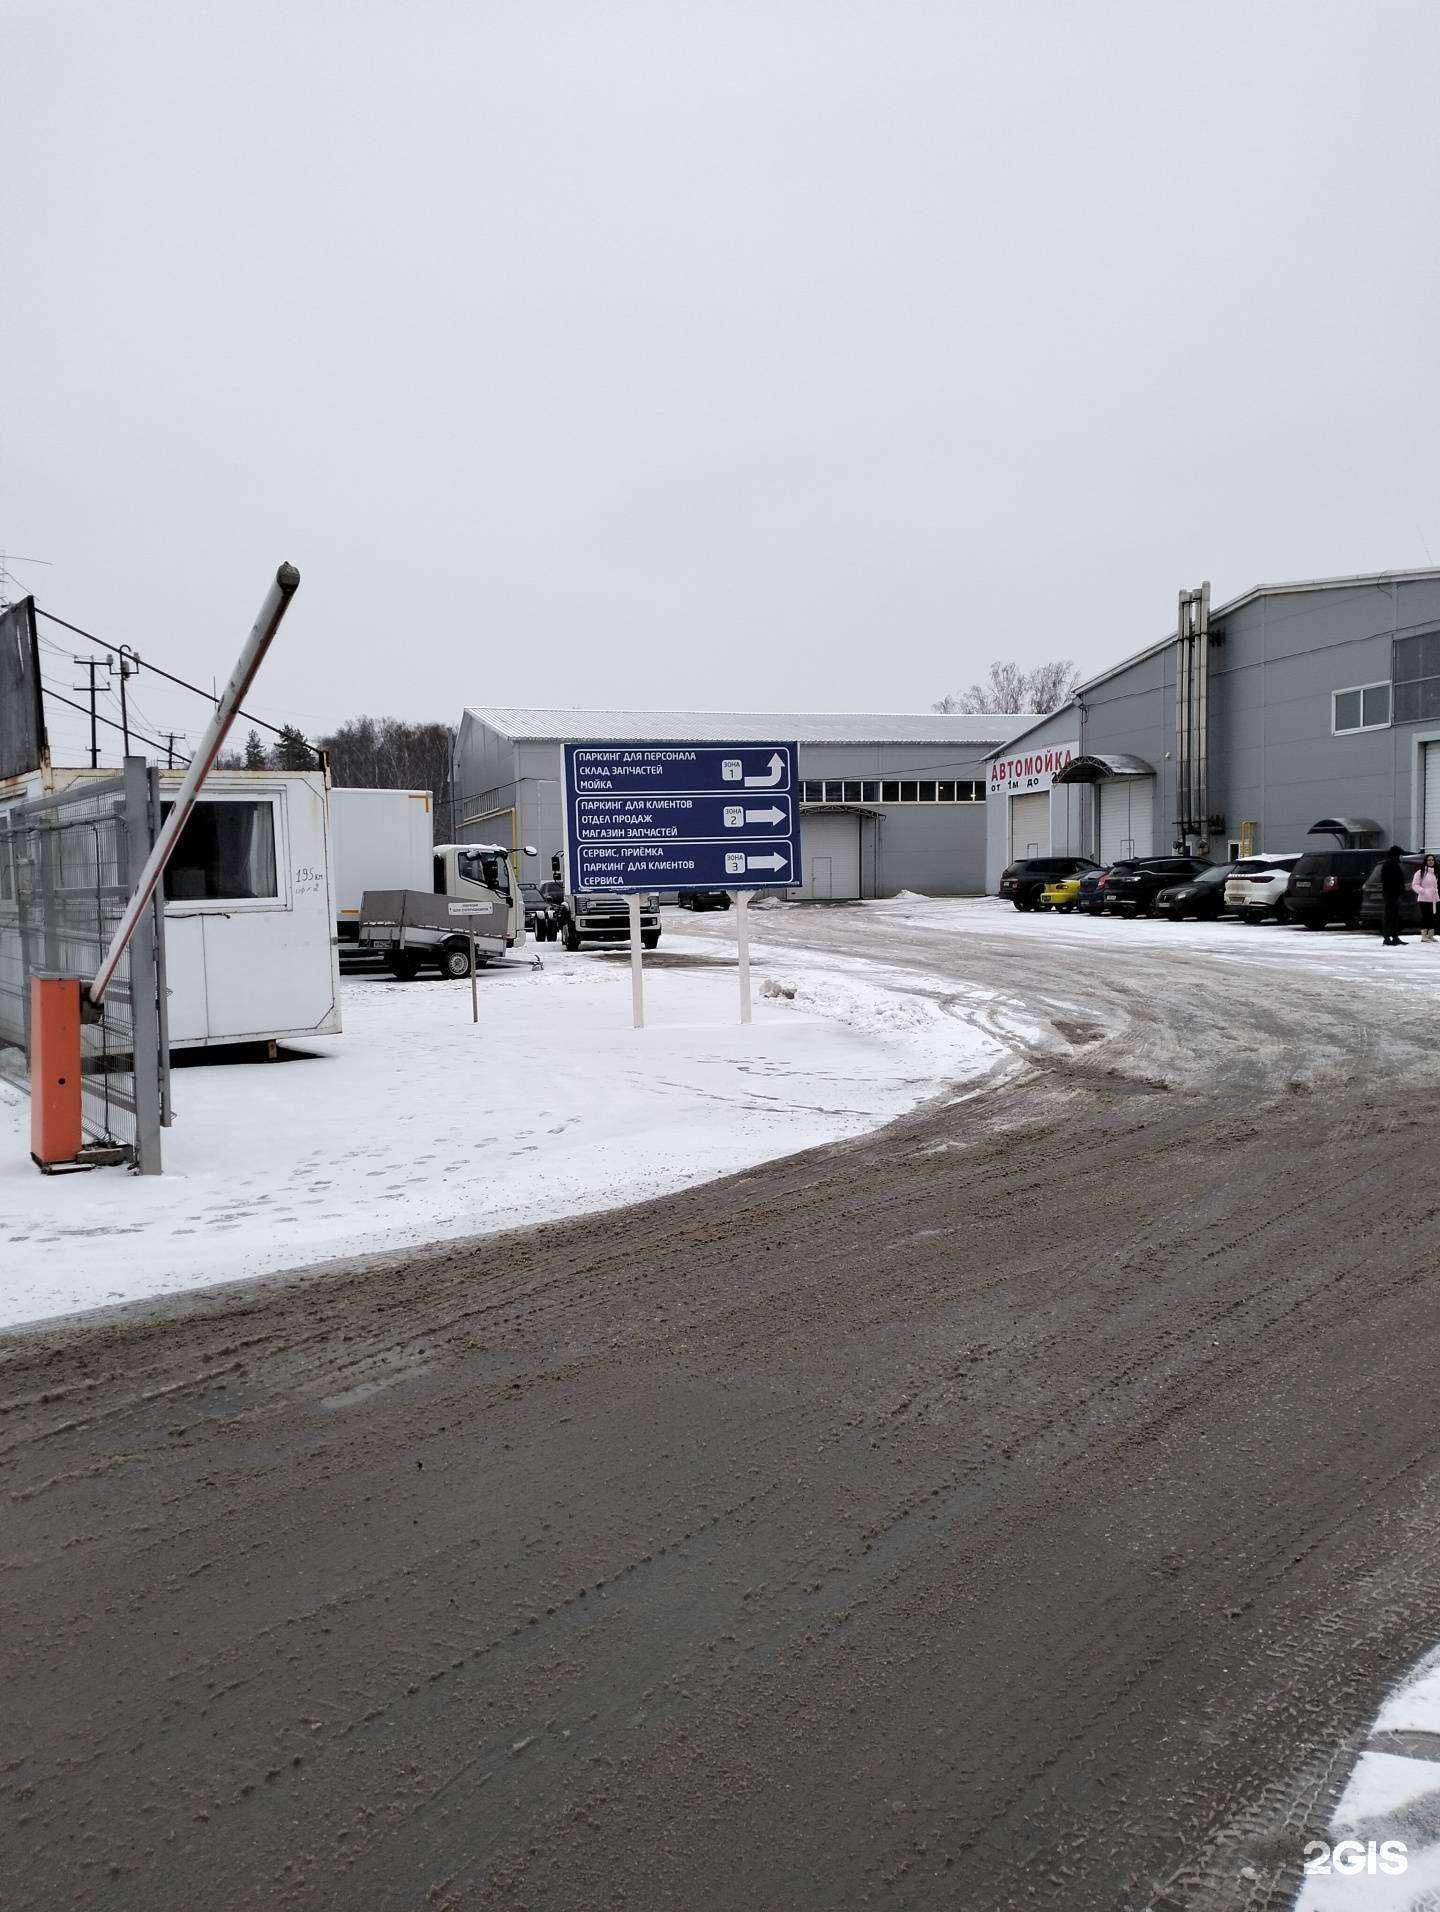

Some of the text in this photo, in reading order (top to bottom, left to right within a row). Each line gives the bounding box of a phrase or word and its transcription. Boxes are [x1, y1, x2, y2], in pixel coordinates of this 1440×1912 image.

[579, 751, 697, 762] ПАРКИНГ ДЛЯ ПЕРСОНАЛА
[579, 765, 663, 776] СКЛАД ЗАПЧАСТЕЙ
[991, 749, 1072, 782] АВТОМОЙКА
[729, 769, 735, 779] 1
[580, 778, 613, 789] МОЙКА
[581, 800, 693, 811] ПАРКИНГ ДЛЯ КЛИЕНТОВ
[581, 814, 653, 825] ОТДЕЛ ПРОДАЖ
[730, 816, 737, 825] 2
[582, 826, 678, 838] МАГАЗИН ЗАПЧАСТЕЙ
[582, 847, 664, 858] СЕРВИС, ПРИЁМКА
[583, 860, 695, 872] ПАРКИНГ ДЛЯ КЛИЕНТОВ
[732, 862, 739, 872] 3
[584, 876, 624, 886] СЕРВИСА
